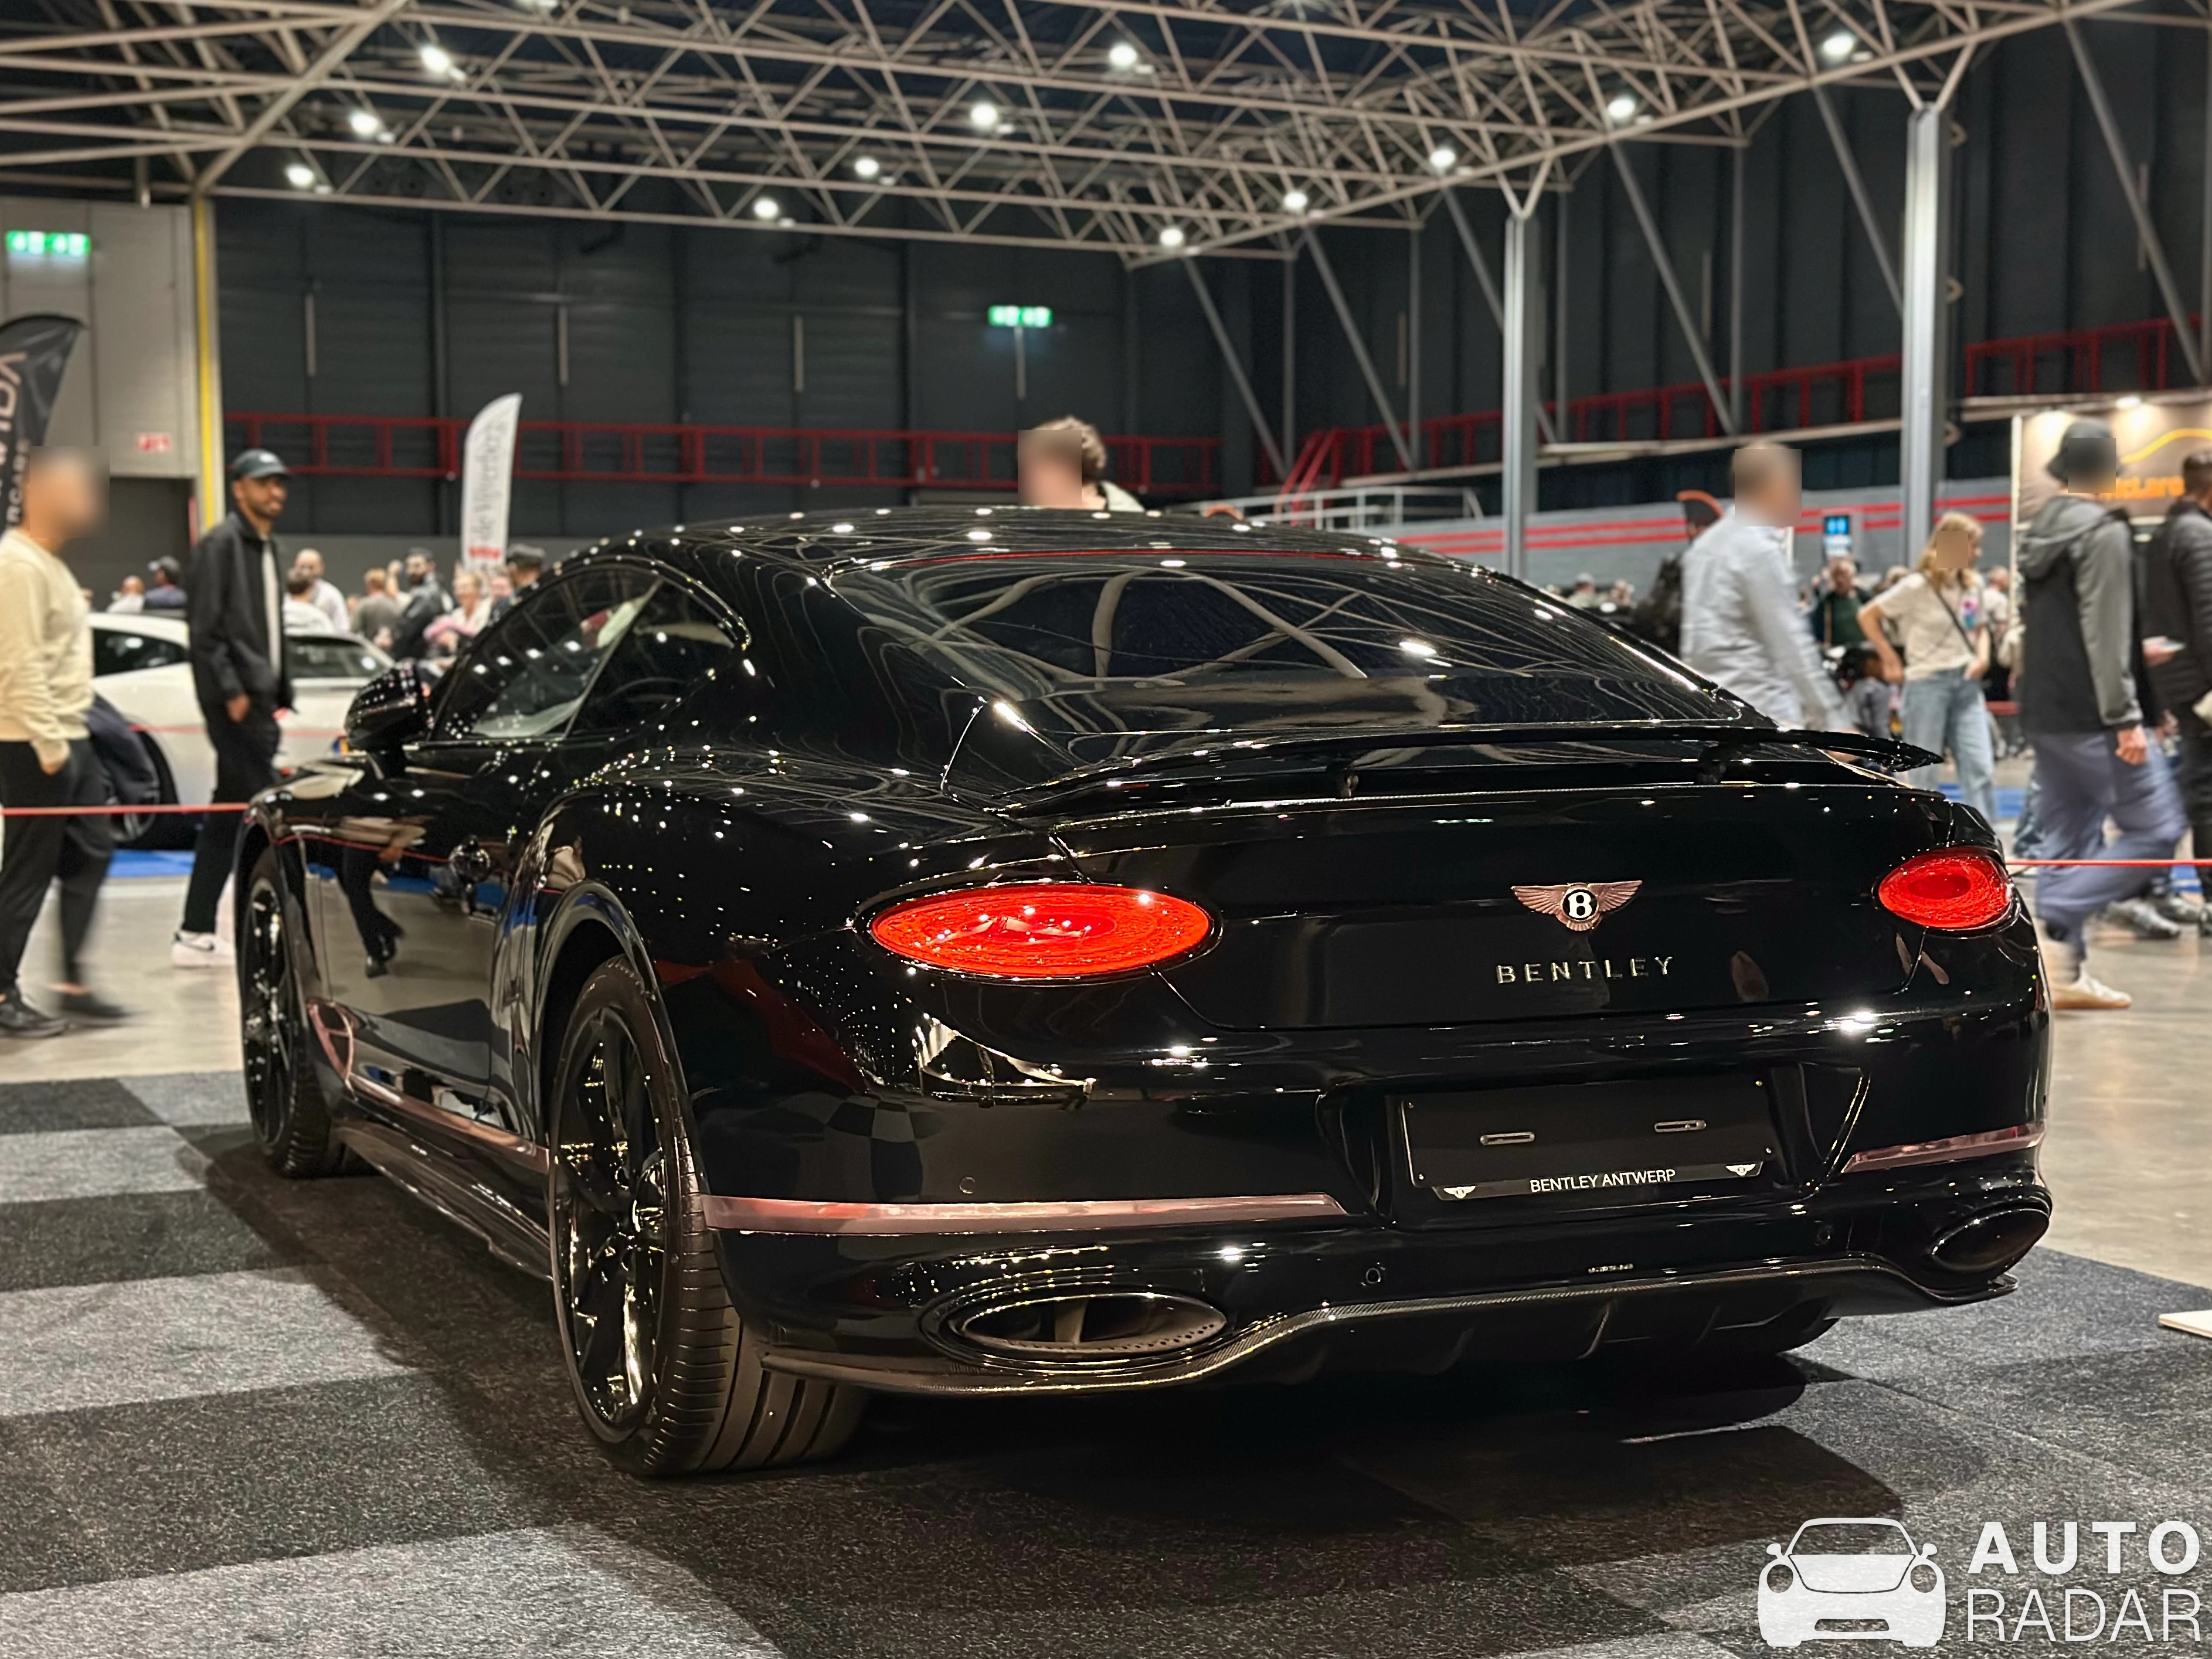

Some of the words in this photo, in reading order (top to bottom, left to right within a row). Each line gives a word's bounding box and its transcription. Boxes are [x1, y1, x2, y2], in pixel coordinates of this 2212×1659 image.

[1568, 892, 1592, 919] B
[1497, 956, 1673, 984] BENTLEY
[1530, 1175, 1598, 1192] BENTLEY
[1602, 1169, 1676, 1187] ANTWERP
